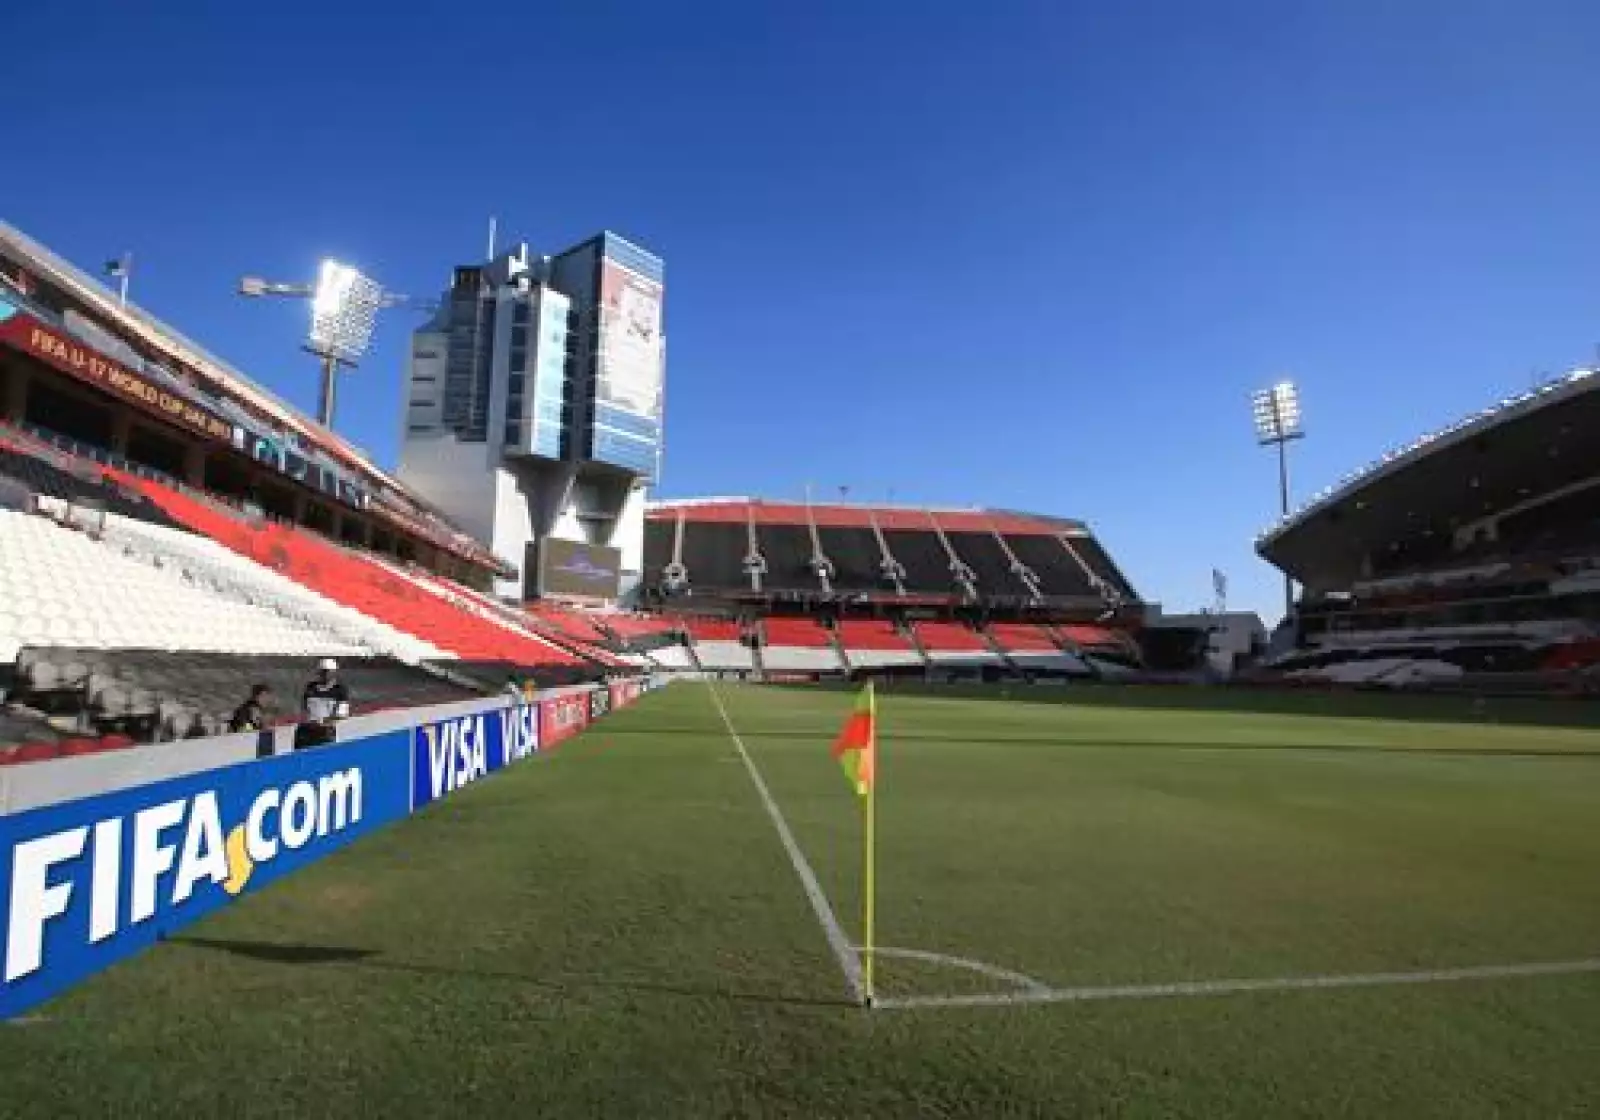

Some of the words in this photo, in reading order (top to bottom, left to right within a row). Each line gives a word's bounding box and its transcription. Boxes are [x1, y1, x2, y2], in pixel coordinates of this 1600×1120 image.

[32, 330, 68, 361] FIFA
[423, 714, 488, 799] VISA
[501, 705, 539, 766] VISA
[5, 767, 364, 984] FIFA.com
